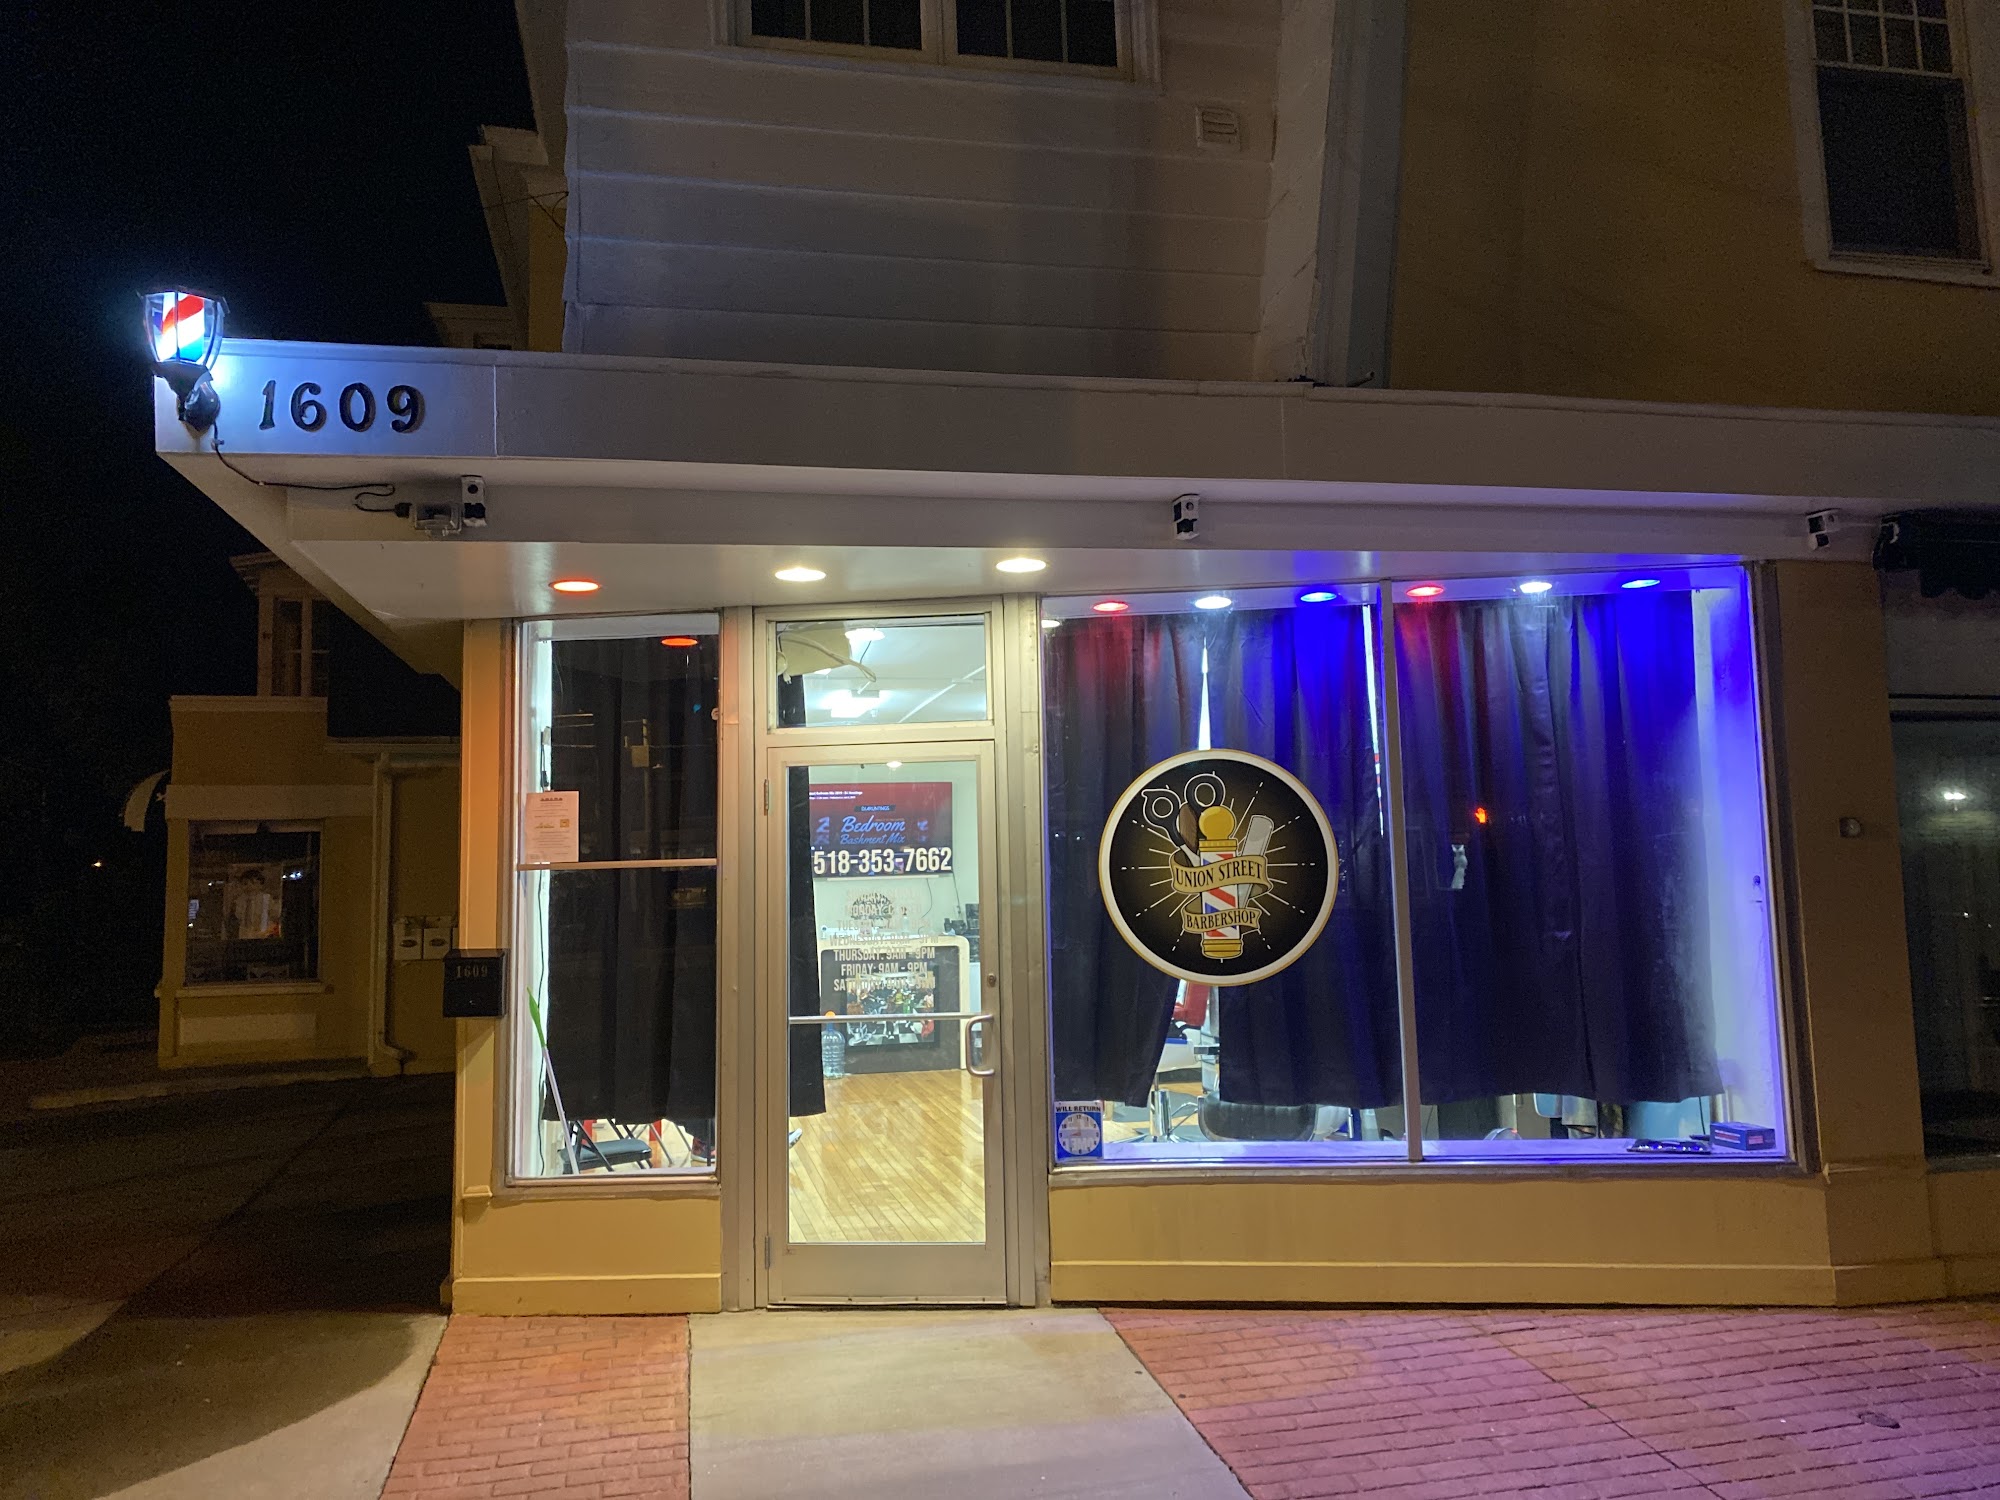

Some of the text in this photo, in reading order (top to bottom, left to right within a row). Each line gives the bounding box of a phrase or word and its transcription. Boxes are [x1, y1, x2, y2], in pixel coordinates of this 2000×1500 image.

[258, 379, 426, 434] 1609
[840, 815, 906, 833] Bedroom
[840, 832, 906, 845] Bashment Mix
[813, 847, 952, 875] 518-353-7662
[1175, 859, 1263, 888] UNION STREET
[1186, 910, 1256, 929] BARBERSHOP
[833, 947, 884, 962] THURSDAY:
[886, 947, 907, 960] 9AM
[915, 946, 936, 960] 9PM
[457, 964, 488, 978] 1609
[841, 963, 877, 976] FRIDAY:
[878, 962, 899, 975] 9AM
[907, 961, 928, 974] 9PM
